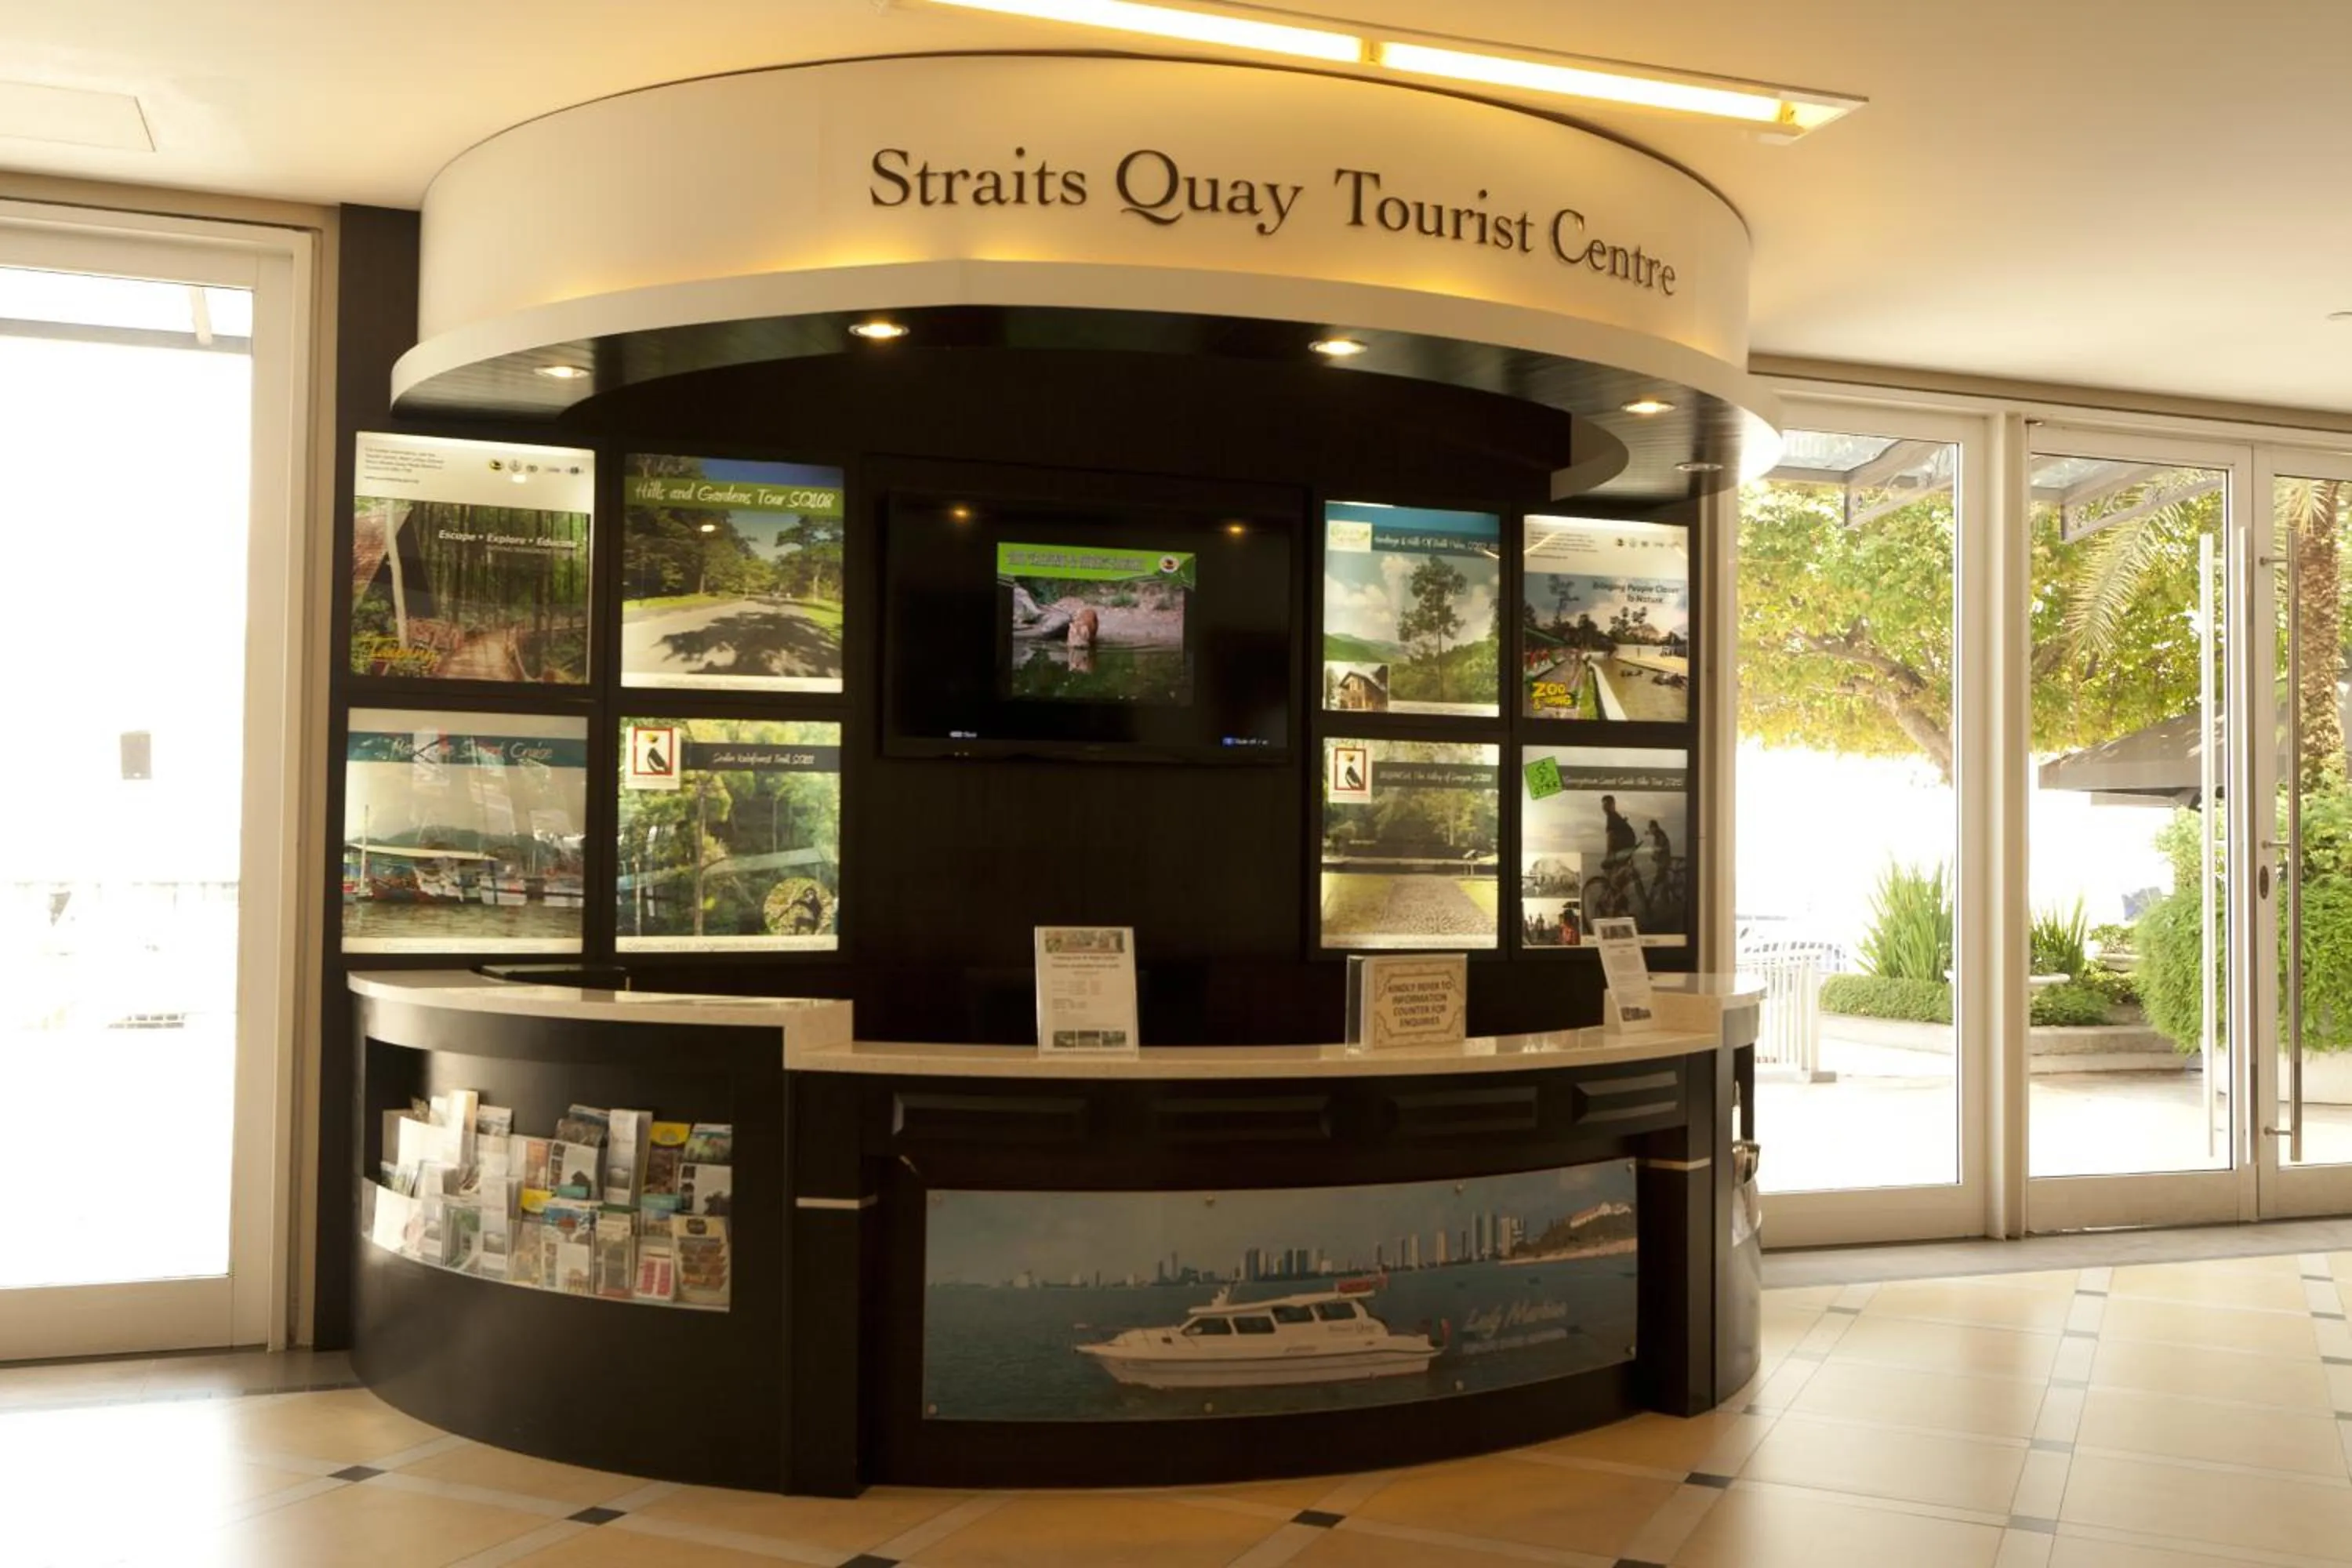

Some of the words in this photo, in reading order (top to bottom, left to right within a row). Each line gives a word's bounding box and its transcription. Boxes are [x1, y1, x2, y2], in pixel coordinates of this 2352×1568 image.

[869, 147, 1087, 207] Straits
[1116, 149, 1305, 236] Quay
[1334, 169, 1535, 254] Tourist
[1552, 209, 1677, 298] Centre
[635, 480, 665, 500] Hills
[670, 483, 695, 500] and
[697, 483, 752, 504] Gardens
[757, 488, 785, 506] Tour
[438, 529, 477, 543] Escape
[486, 532, 527, 546] Explore
[1388, 982, 1415, 993] KINDLY
[1417, 982, 1439, 992] REFER
[1441, 980, 1453, 990] TO
[1392, 993, 1447, 1004] INFORMATION
[1393, 1006, 1429, 1016] COUNTER
[1432, 1004, 1446, 1014] FOR
[1399, 1017, 1440, 1027] ENQUIRIES
